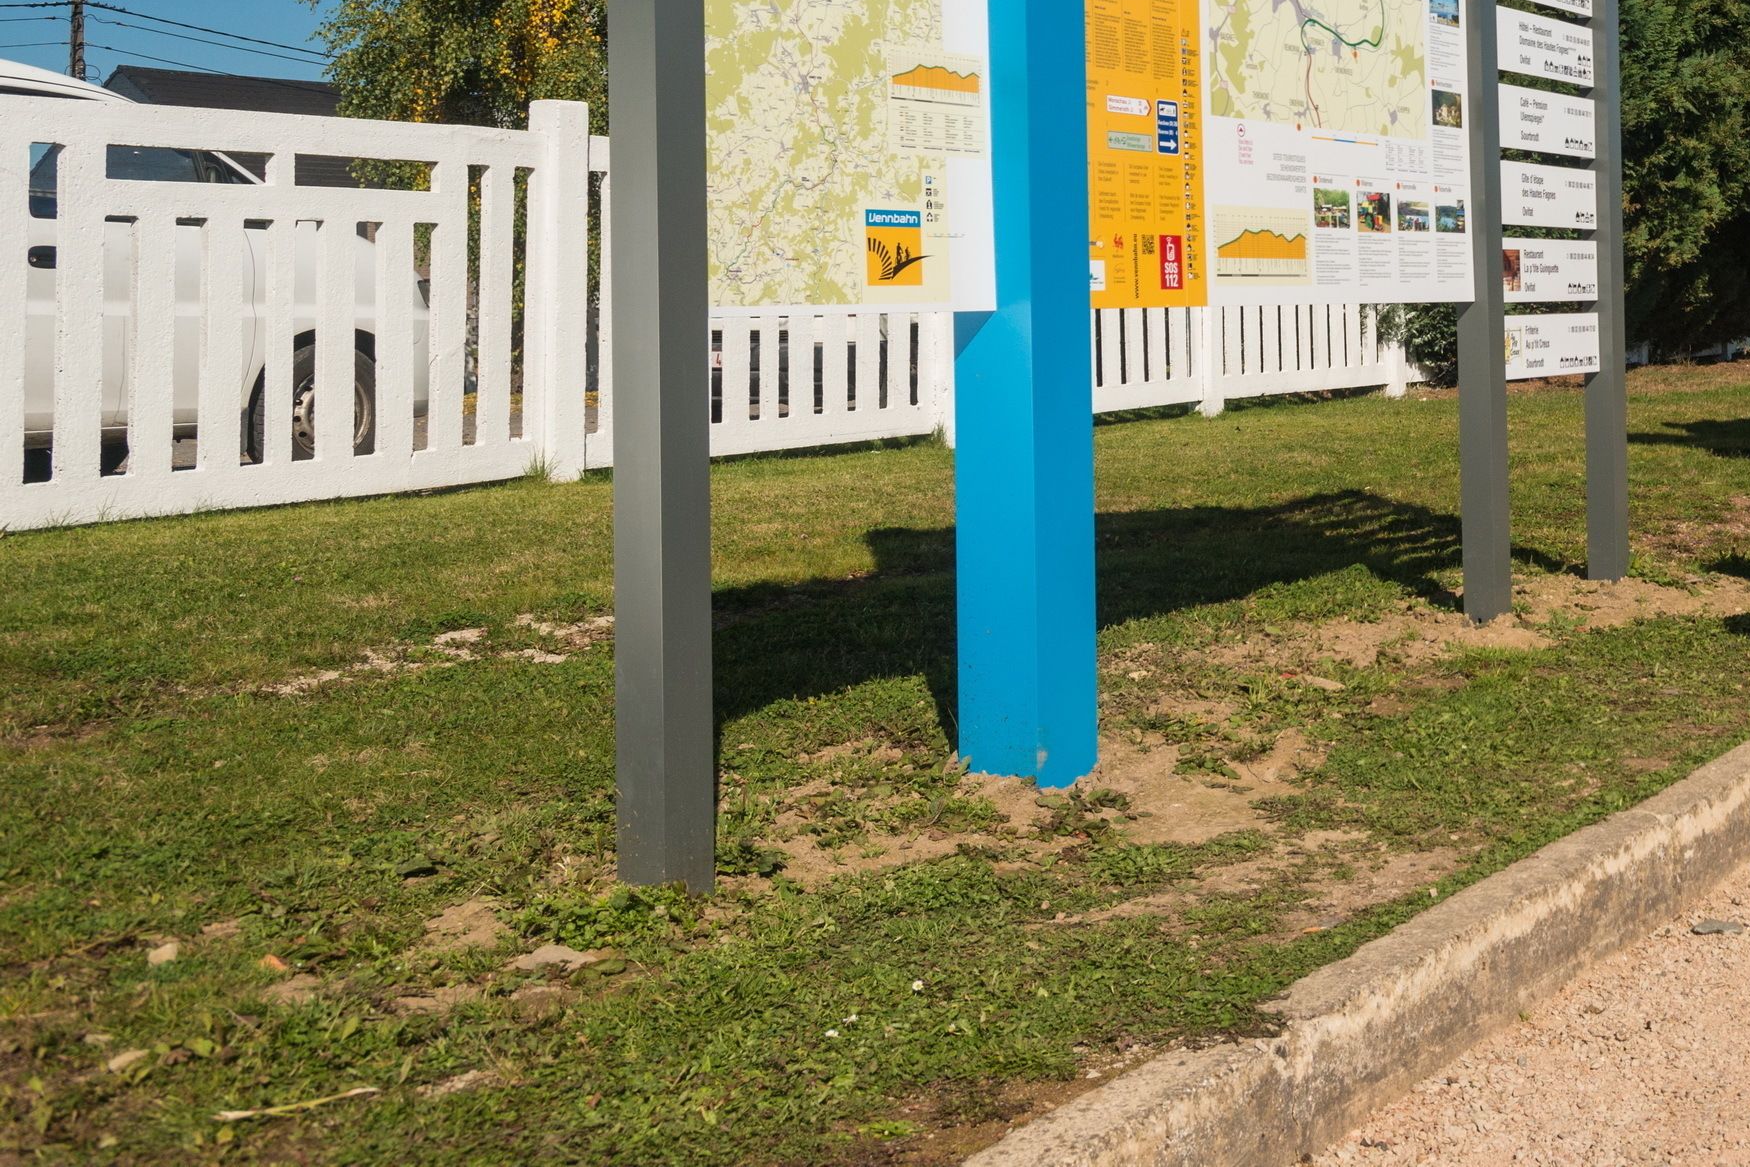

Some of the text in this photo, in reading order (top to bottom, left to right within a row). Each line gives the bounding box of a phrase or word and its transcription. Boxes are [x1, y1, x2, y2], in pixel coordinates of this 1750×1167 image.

[1518, 35, 1535, 48] Domaine
[1520, 96, 1528, 107] Café
[1532, 99, 1547, 110] Pension
[1529, 189, 1542, 198] Hautes
[1543, 188, 1555, 201] Fagnes
[868, 212, 918, 224] Vennbahn
[1523, 249, 1543, 258] Restaurant
[1164, 262, 1179, 274] SOS
[1524, 264, 1529, 272] La
[1165, 274, 1179, 287] 112
[1525, 340, 1530, 348] Au
